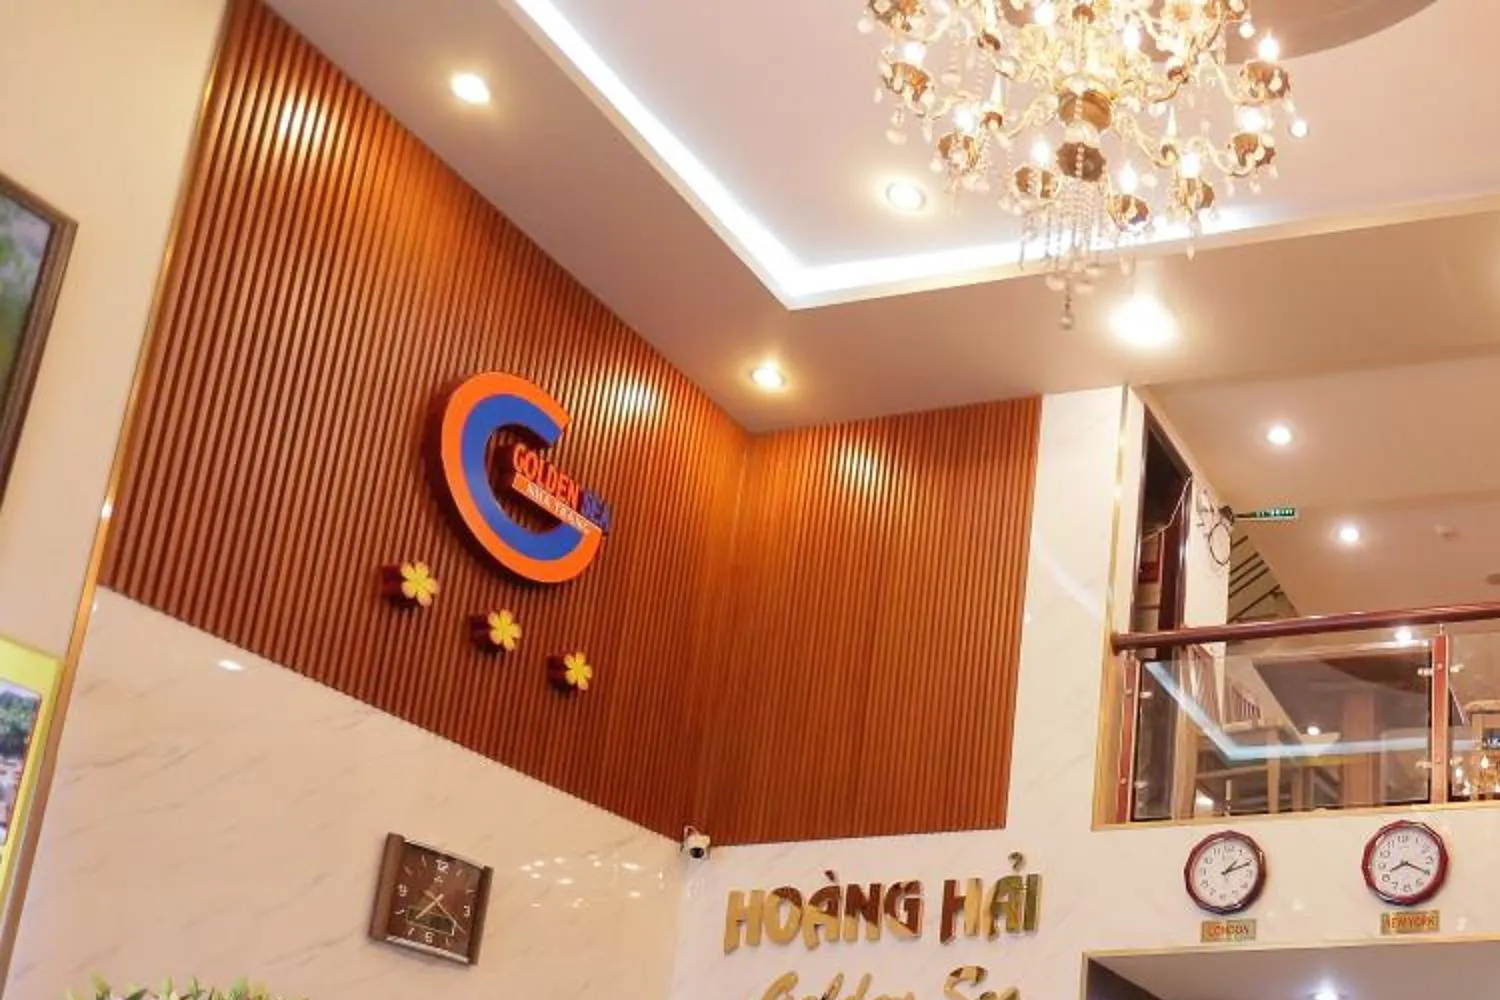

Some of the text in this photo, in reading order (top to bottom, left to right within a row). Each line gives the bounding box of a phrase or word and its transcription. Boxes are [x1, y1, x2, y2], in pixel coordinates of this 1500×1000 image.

[513, 443, 579, 511] GOLDEN
[724, 851, 1043, 955] HOÀNG HẢI
